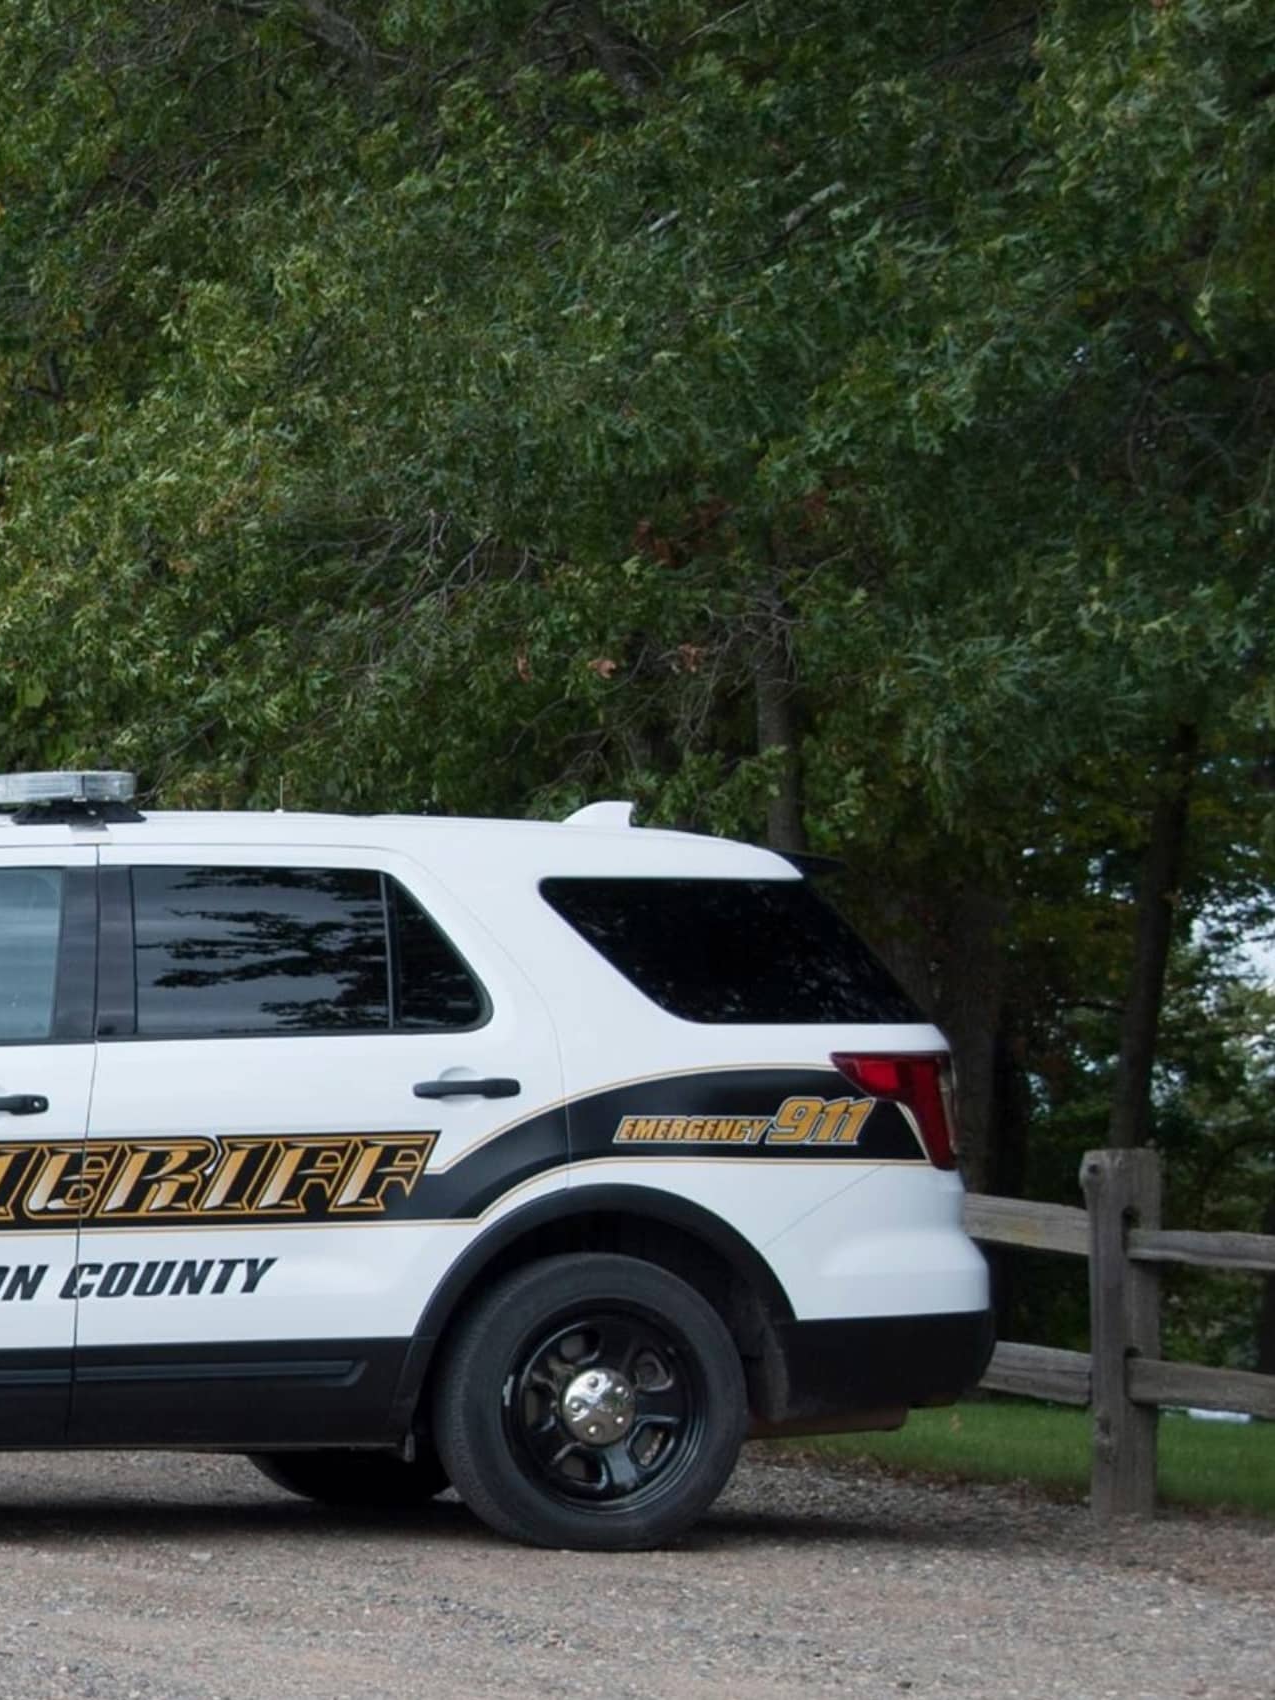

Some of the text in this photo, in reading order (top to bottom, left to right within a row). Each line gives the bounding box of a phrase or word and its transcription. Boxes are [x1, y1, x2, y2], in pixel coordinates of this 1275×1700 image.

[614, 1096, 876, 1145] EMERGENCY 911
[58, 1257, 278, 1299] COUNTY
